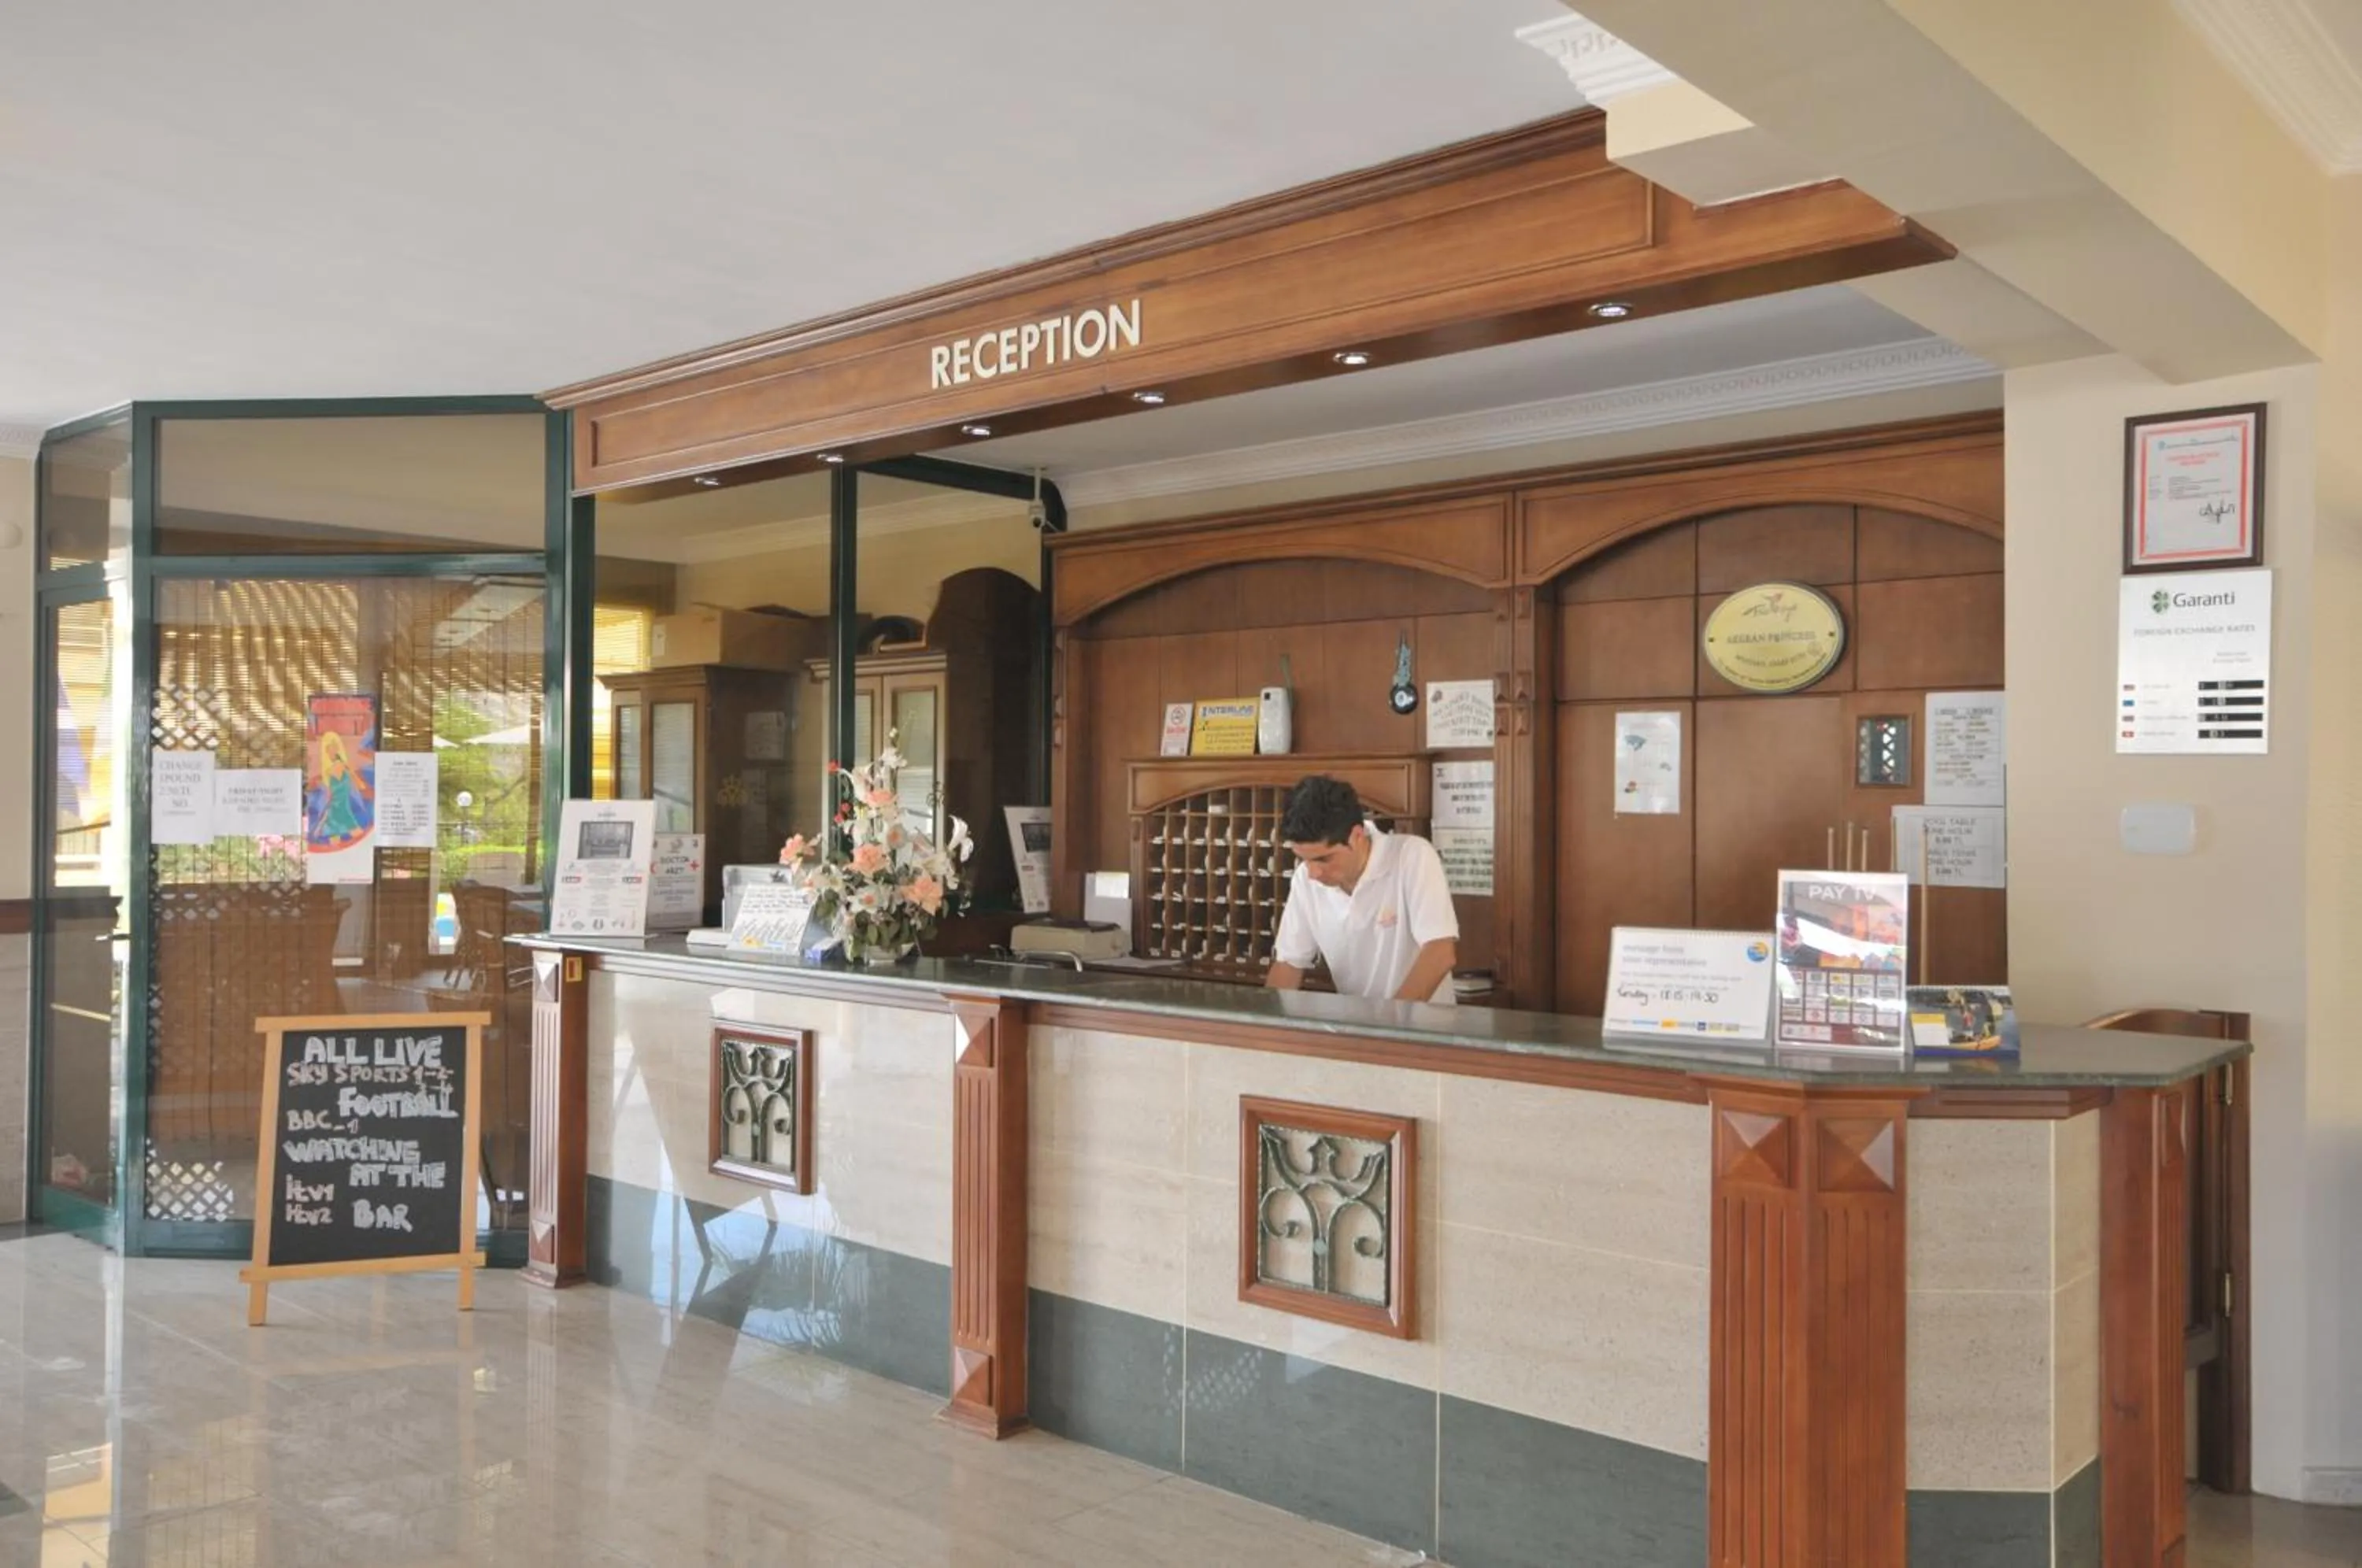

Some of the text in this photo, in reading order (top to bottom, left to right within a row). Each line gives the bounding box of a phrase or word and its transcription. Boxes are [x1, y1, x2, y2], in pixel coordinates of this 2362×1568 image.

[931, 298, 1139, 389] RECEPTION
[2173, 591, 2235, 608] Garanti
[159, 760, 202, 771] CHANGE
[1809, 886, 1877, 900] PAY TV
[304, 1036, 442, 1068] ALL LIVE
[287, 1062, 328, 1087] SKY
[334, 1063, 411, 1084] SPORTS
[338, 1086, 459, 1119] FOOTBALL
[283, 1136, 420, 1164] WATCHING
[349, 1161, 446, 1188] AT THE
[352, 1199, 413, 1232] BAR
